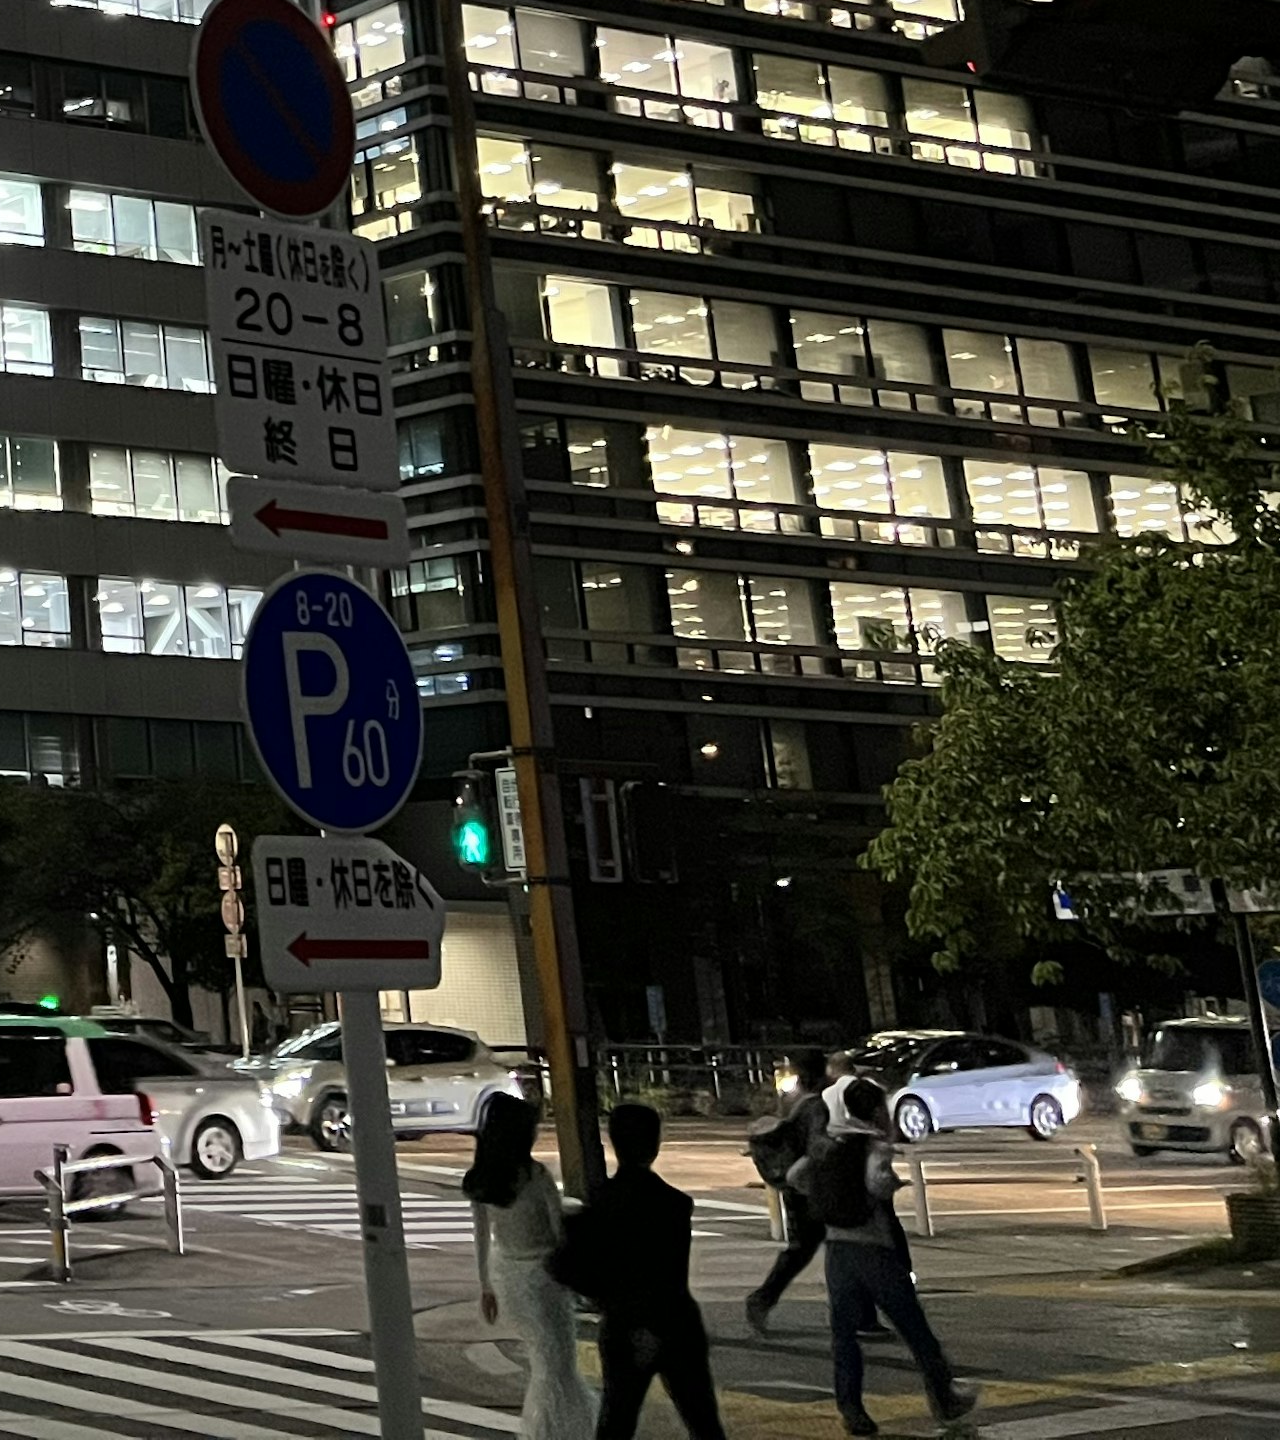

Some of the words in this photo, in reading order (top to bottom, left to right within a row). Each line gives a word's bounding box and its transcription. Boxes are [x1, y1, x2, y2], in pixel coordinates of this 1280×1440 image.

[227, 354, 382, 416] 日曜・休日
[295, 589, 354, 628] 8-20
[281, 631, 351, 789] P
[342, 719, 390, 788] 60
[266, 857, 434, 909] 日曜・休日を除く
